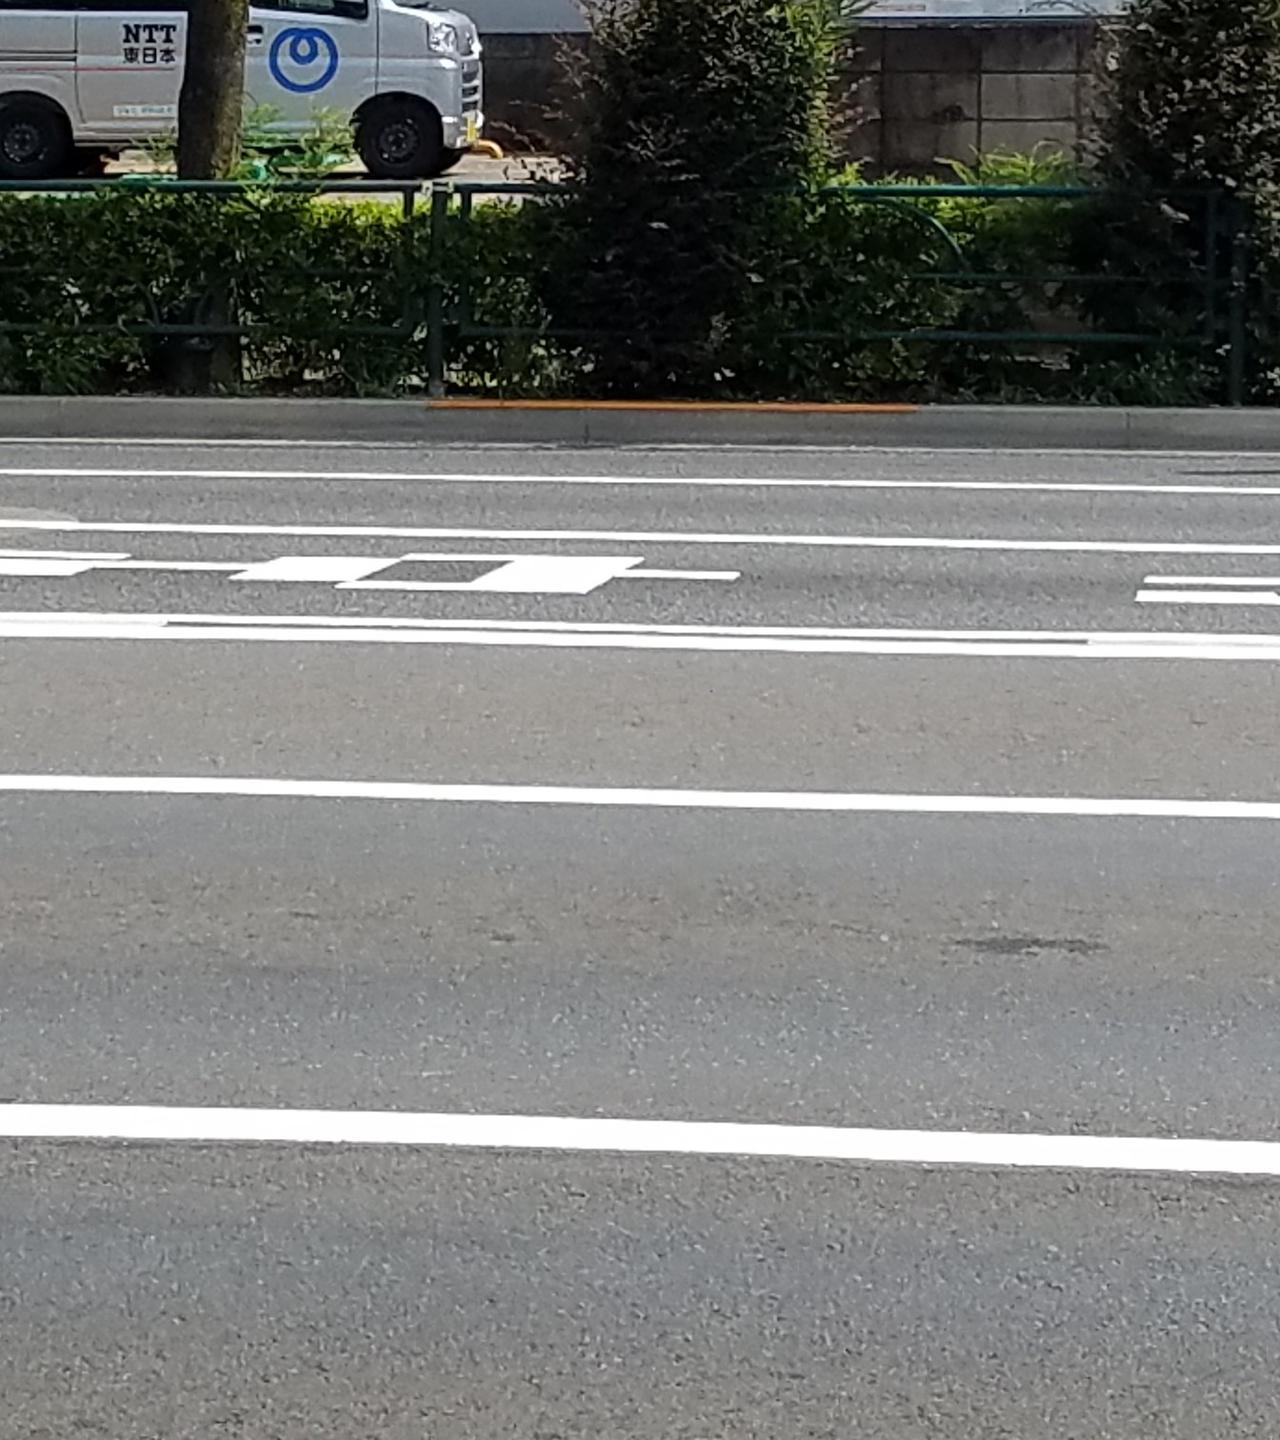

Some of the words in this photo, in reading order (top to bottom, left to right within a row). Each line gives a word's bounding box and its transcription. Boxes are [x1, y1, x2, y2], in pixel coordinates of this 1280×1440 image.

[122, 23, 177, 44] NTT
[122, 46, 177, 64] 東日本
